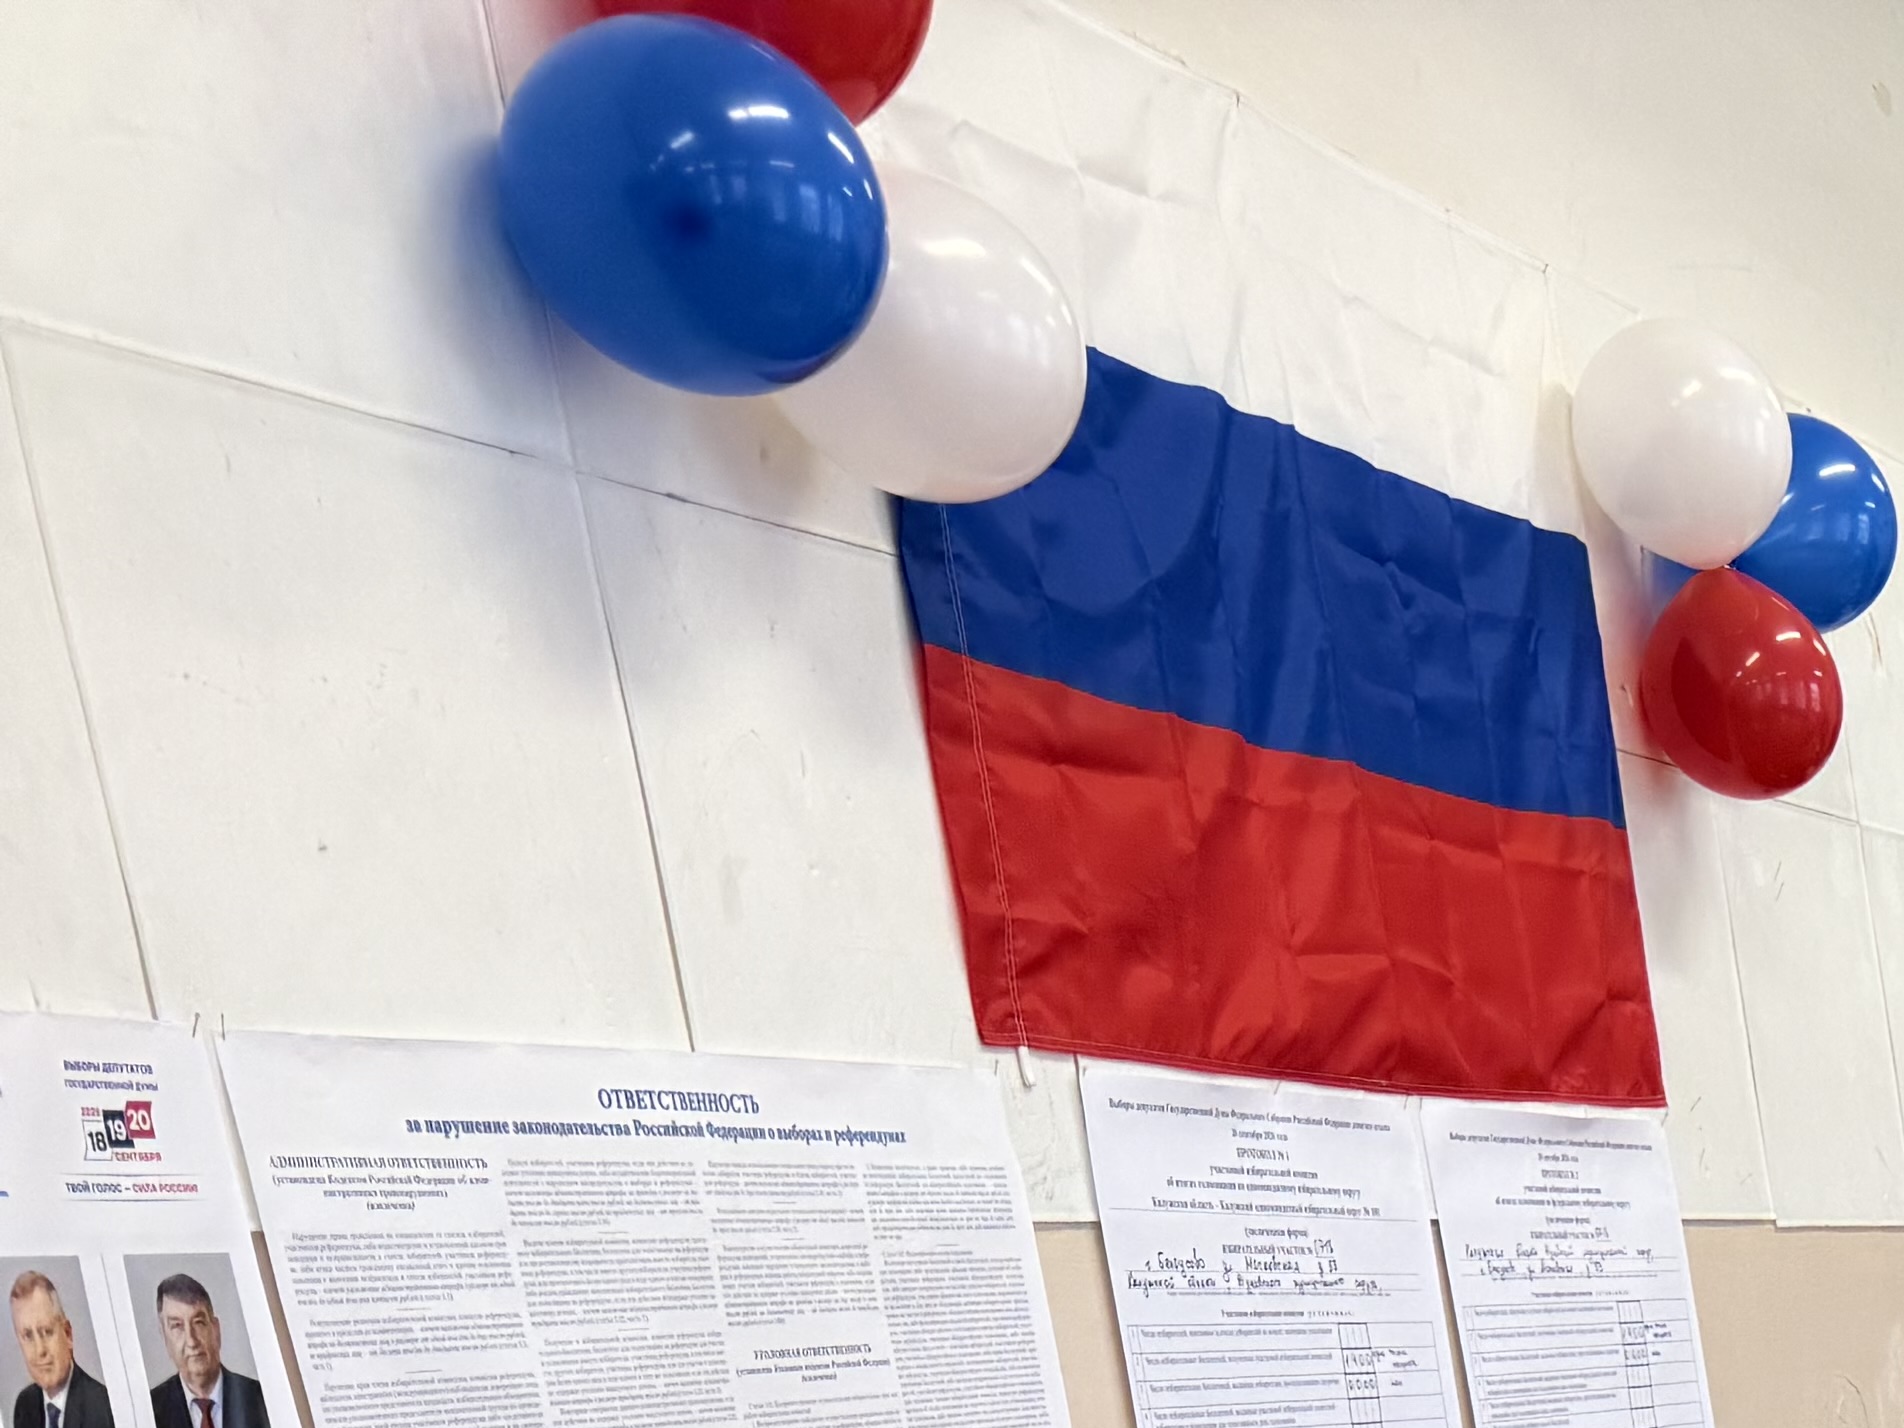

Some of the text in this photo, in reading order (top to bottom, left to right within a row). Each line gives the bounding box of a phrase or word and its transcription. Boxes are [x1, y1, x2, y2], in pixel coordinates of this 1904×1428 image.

[598, 1088, 760, 1115] ОТВЕТСТВЕННОСТЬ
[87, 1109, 151, 1152] 18 19 20
[406, 1118, 422, 1133] за
[425, 1119, 510, 1139] нарушение
[512, 1120, 631, 1138] законодательства
[632, 1119, 705, 1138] Российской
[706, 1122, 766, 1144] Федерации
[777, 1124, 823, 1146] выборах
[834, 1126, 907, 1147] референдумах
